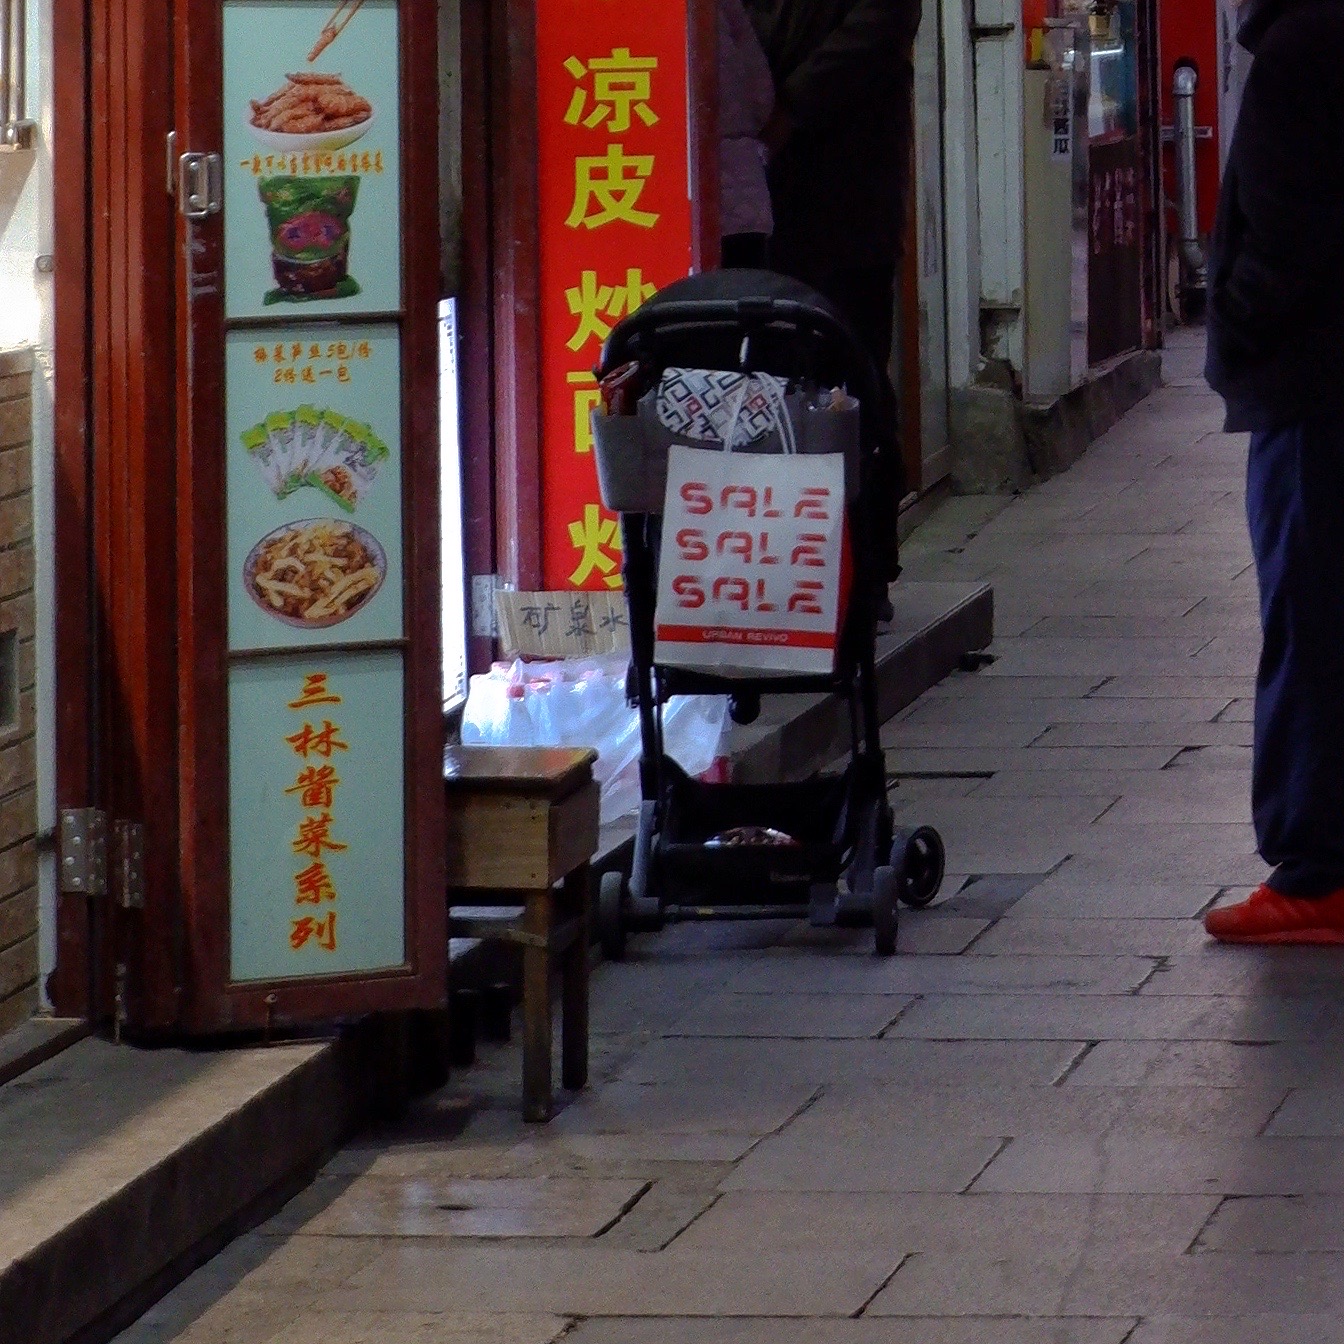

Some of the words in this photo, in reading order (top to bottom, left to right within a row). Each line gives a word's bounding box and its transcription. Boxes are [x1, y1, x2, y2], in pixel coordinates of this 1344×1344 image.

[679, 482, 830, 520] SALE
[675, 528, 827, 567] SALE
[671, 574, 823, 614] SALE
[520, 599, 629, 638] 矿泉水
[284, 673, 348, 952] 三林酱菜系列
